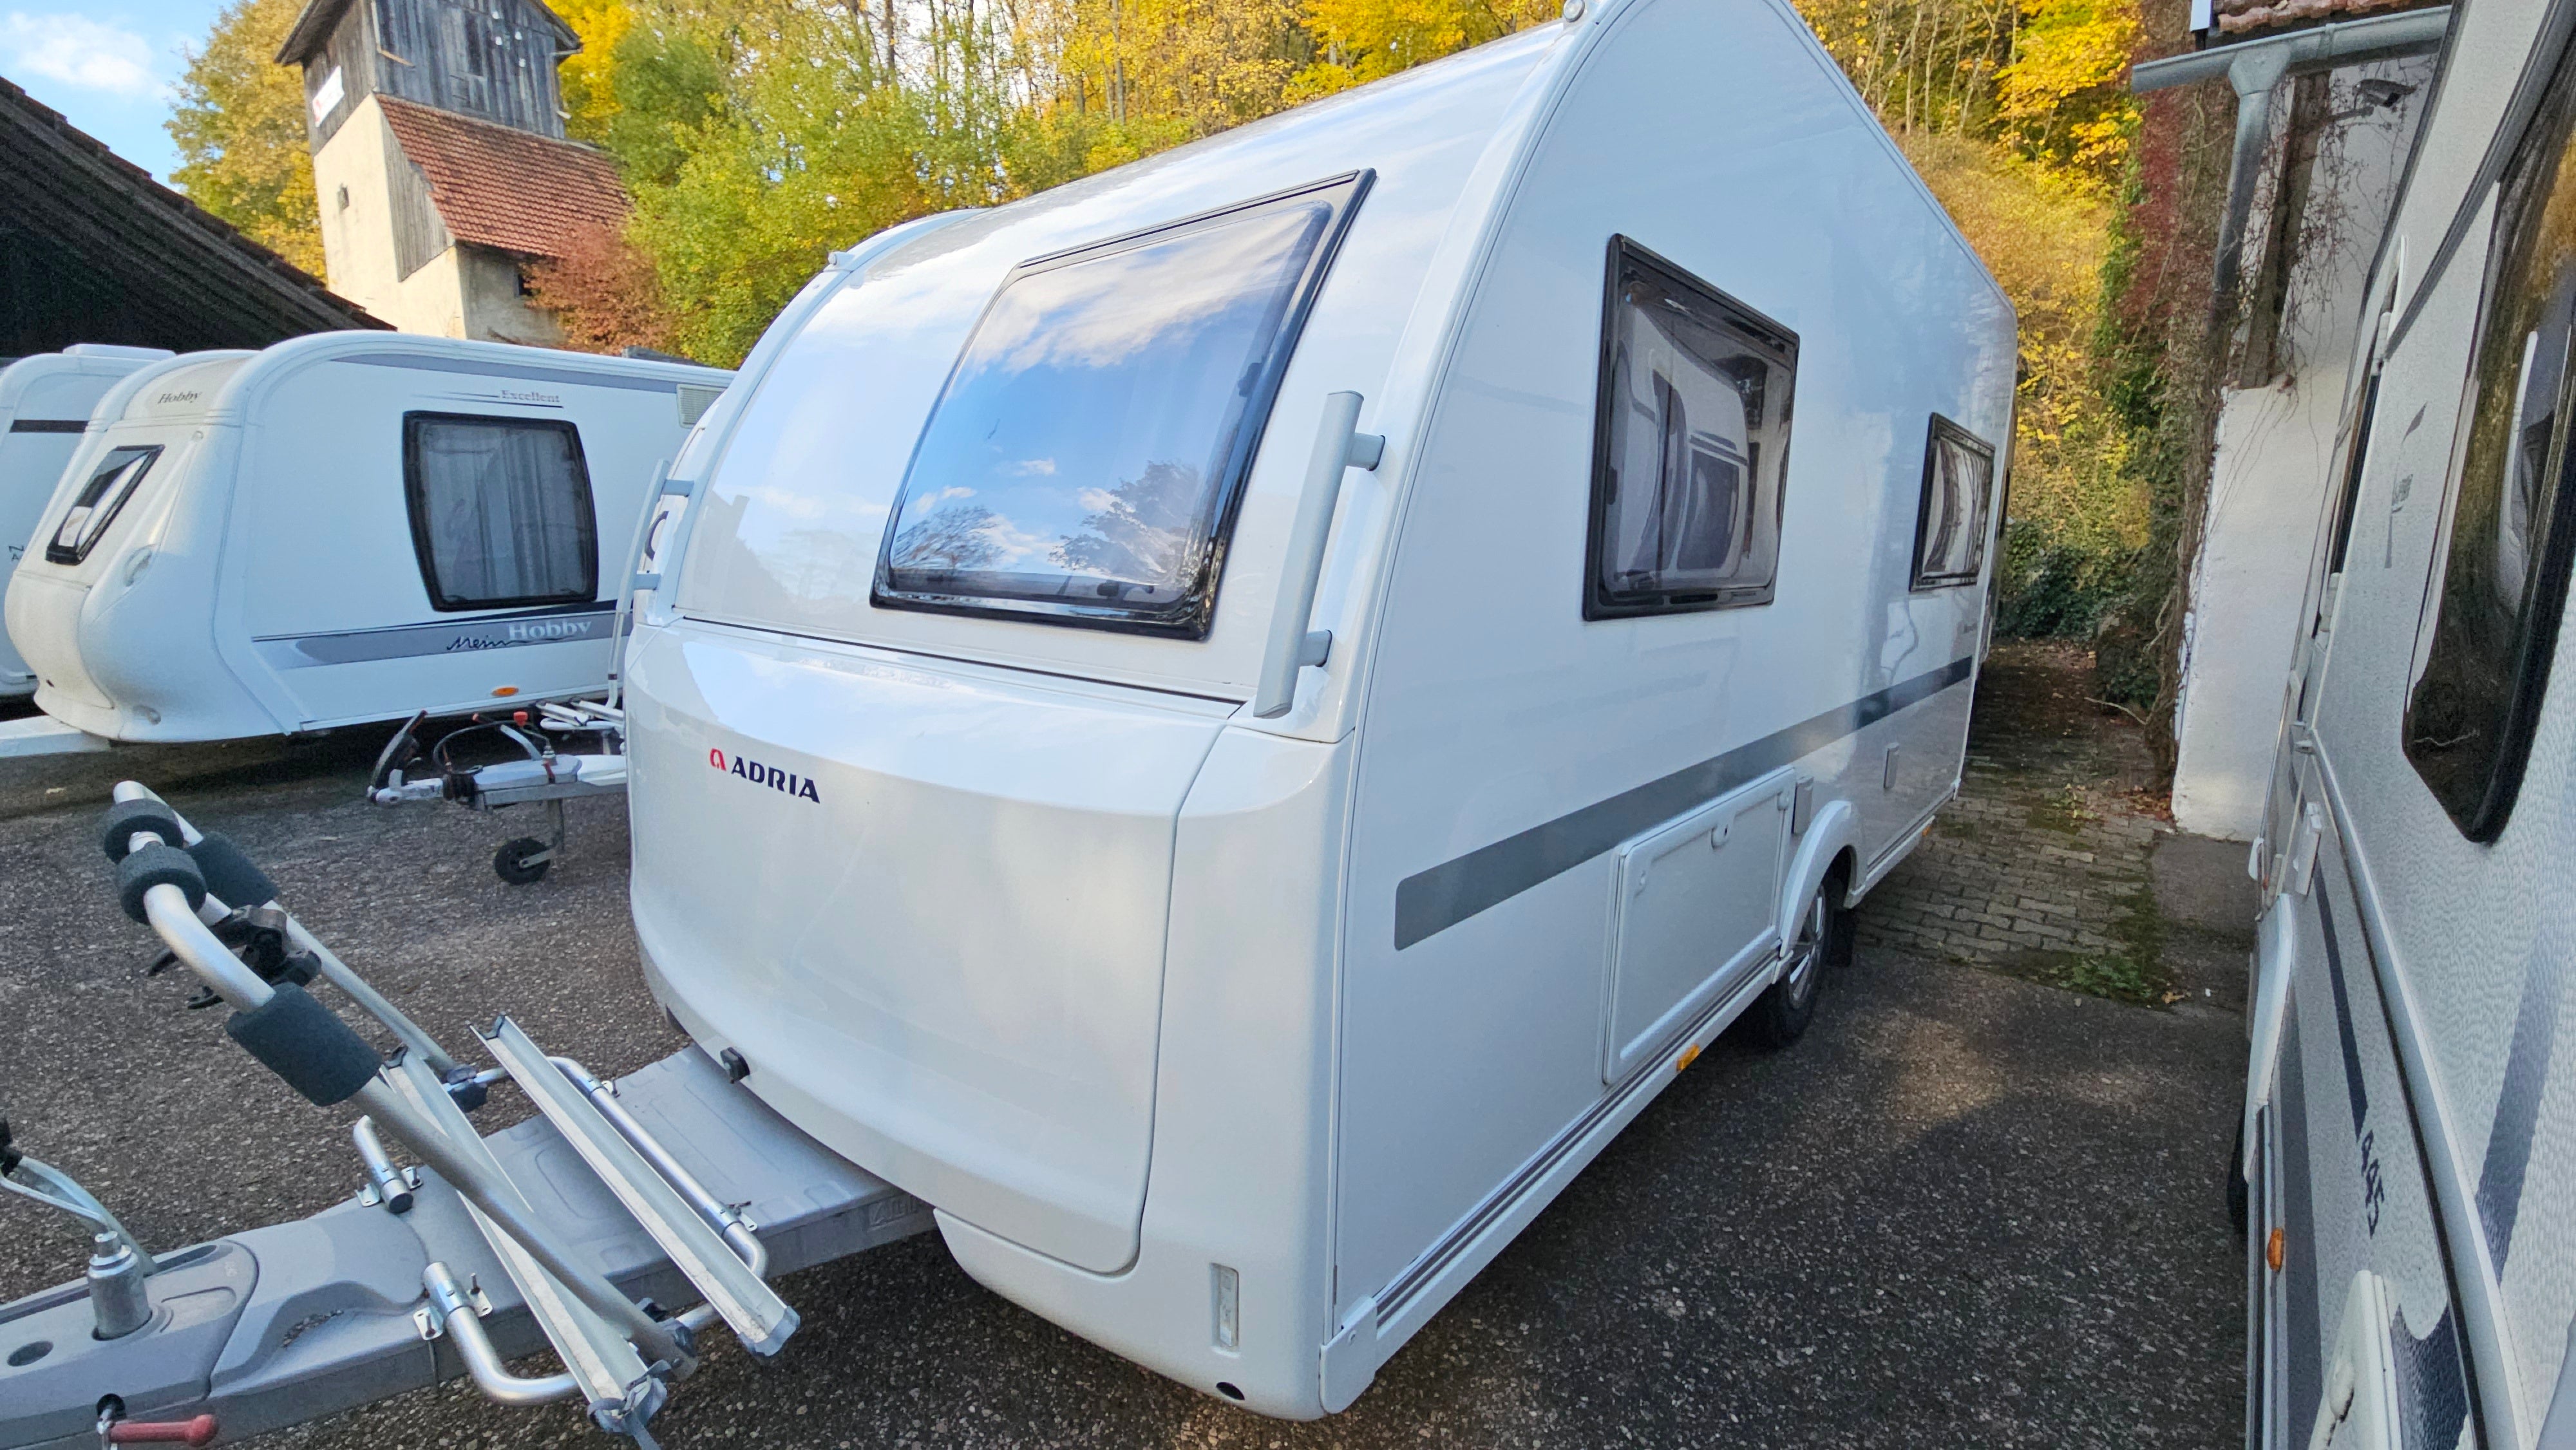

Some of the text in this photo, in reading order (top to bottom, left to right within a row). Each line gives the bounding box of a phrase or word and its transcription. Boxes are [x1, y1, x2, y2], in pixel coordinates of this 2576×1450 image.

[158, 391, 202, 404] Hobby
[502, 390, 560, 402] Excellent
[446, 620, 592, 650] Mein Hobby
[731, 755, 820, 804] ADRIA
